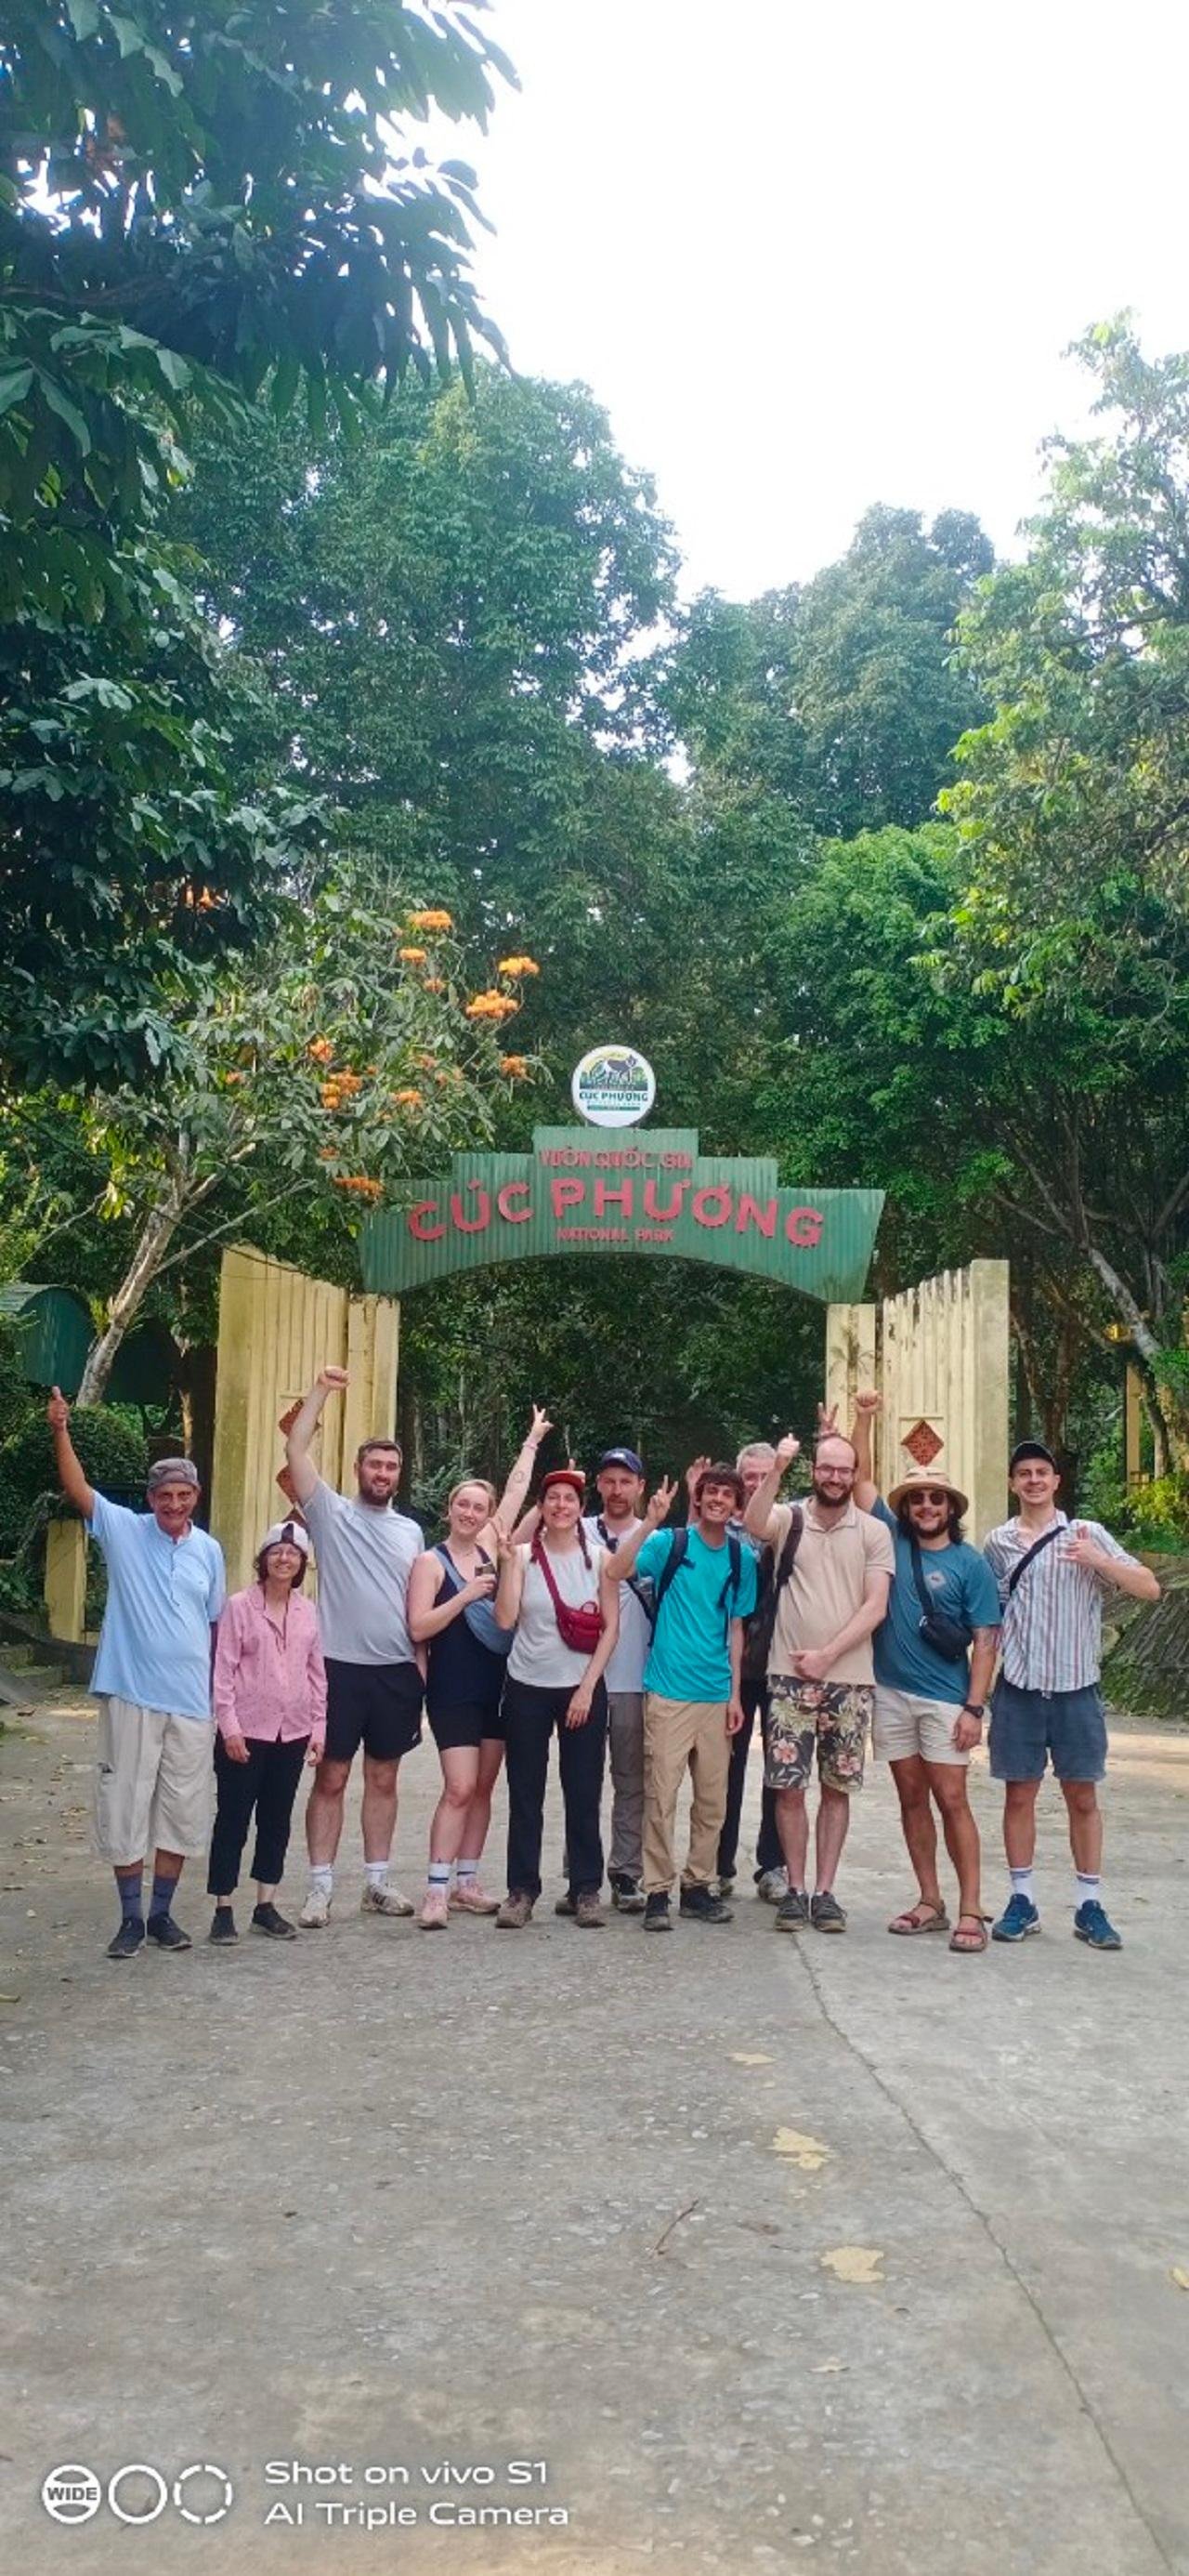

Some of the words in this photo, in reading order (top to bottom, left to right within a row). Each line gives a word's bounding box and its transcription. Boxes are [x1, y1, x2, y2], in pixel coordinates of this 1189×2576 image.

[408, 1179, 534, 1242] CÚC
[551, 1177, 824, 1248] PHƯƠNG
[556, 1227, 629, 1242] NATIONAL
[634, 1228, 675, 1242] PARK
